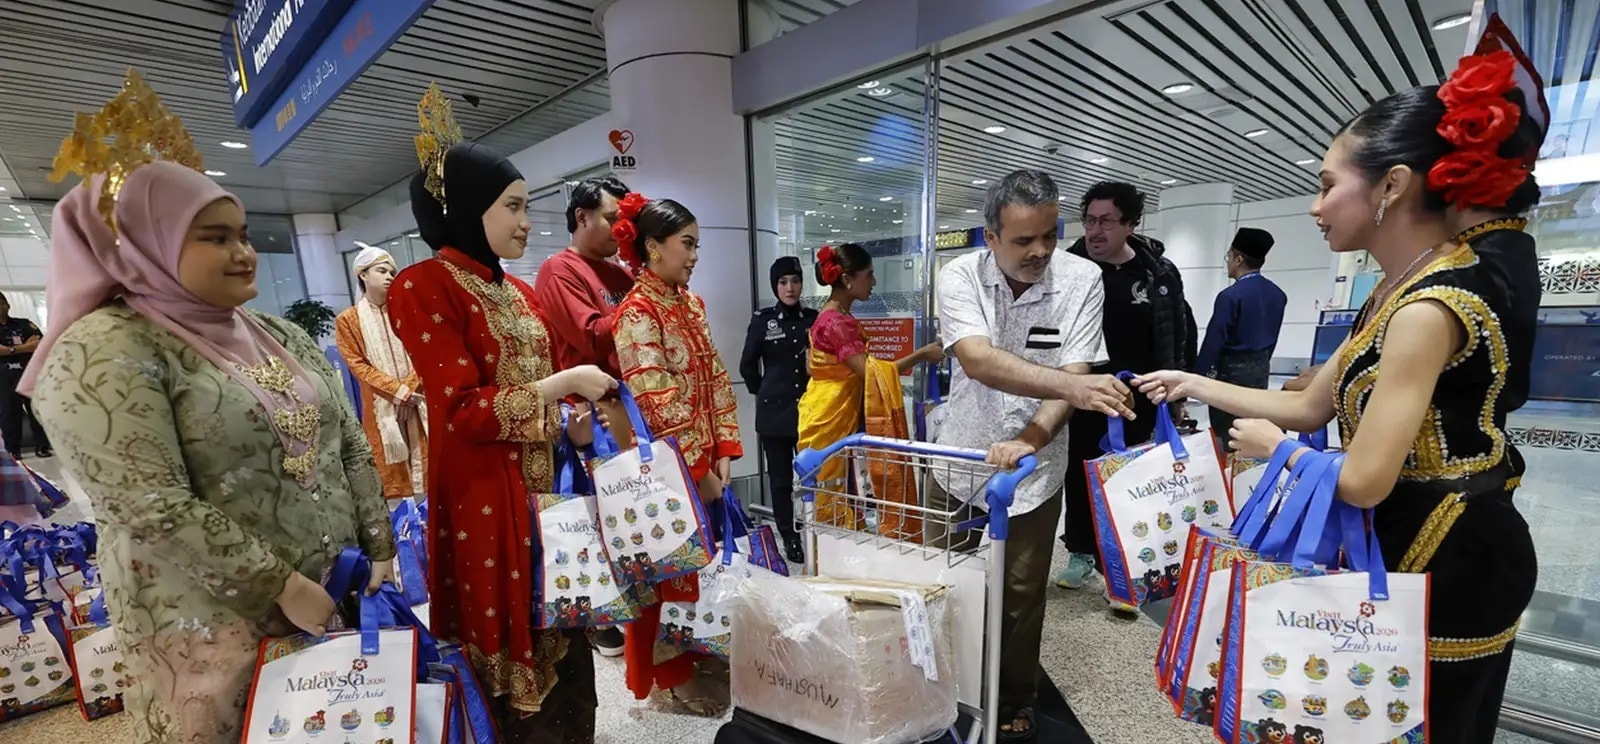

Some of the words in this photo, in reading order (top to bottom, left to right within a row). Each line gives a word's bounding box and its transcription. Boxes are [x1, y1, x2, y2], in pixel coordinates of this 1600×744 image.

[613, 156, 636, 167] AED
[558, 520, 598, 533] Malays
[1276, 608, 1375, 638] Malaysia
[1317, 610, 1341, 619] Visit
[1332, 635, 1372, 653] Truly
[1373, 641, 1398, 653] Asia
[285, 670, 365, 693] Malaysia
[327, 688, 360, 707] Truly
[362, 689, 385, 699] Asia
